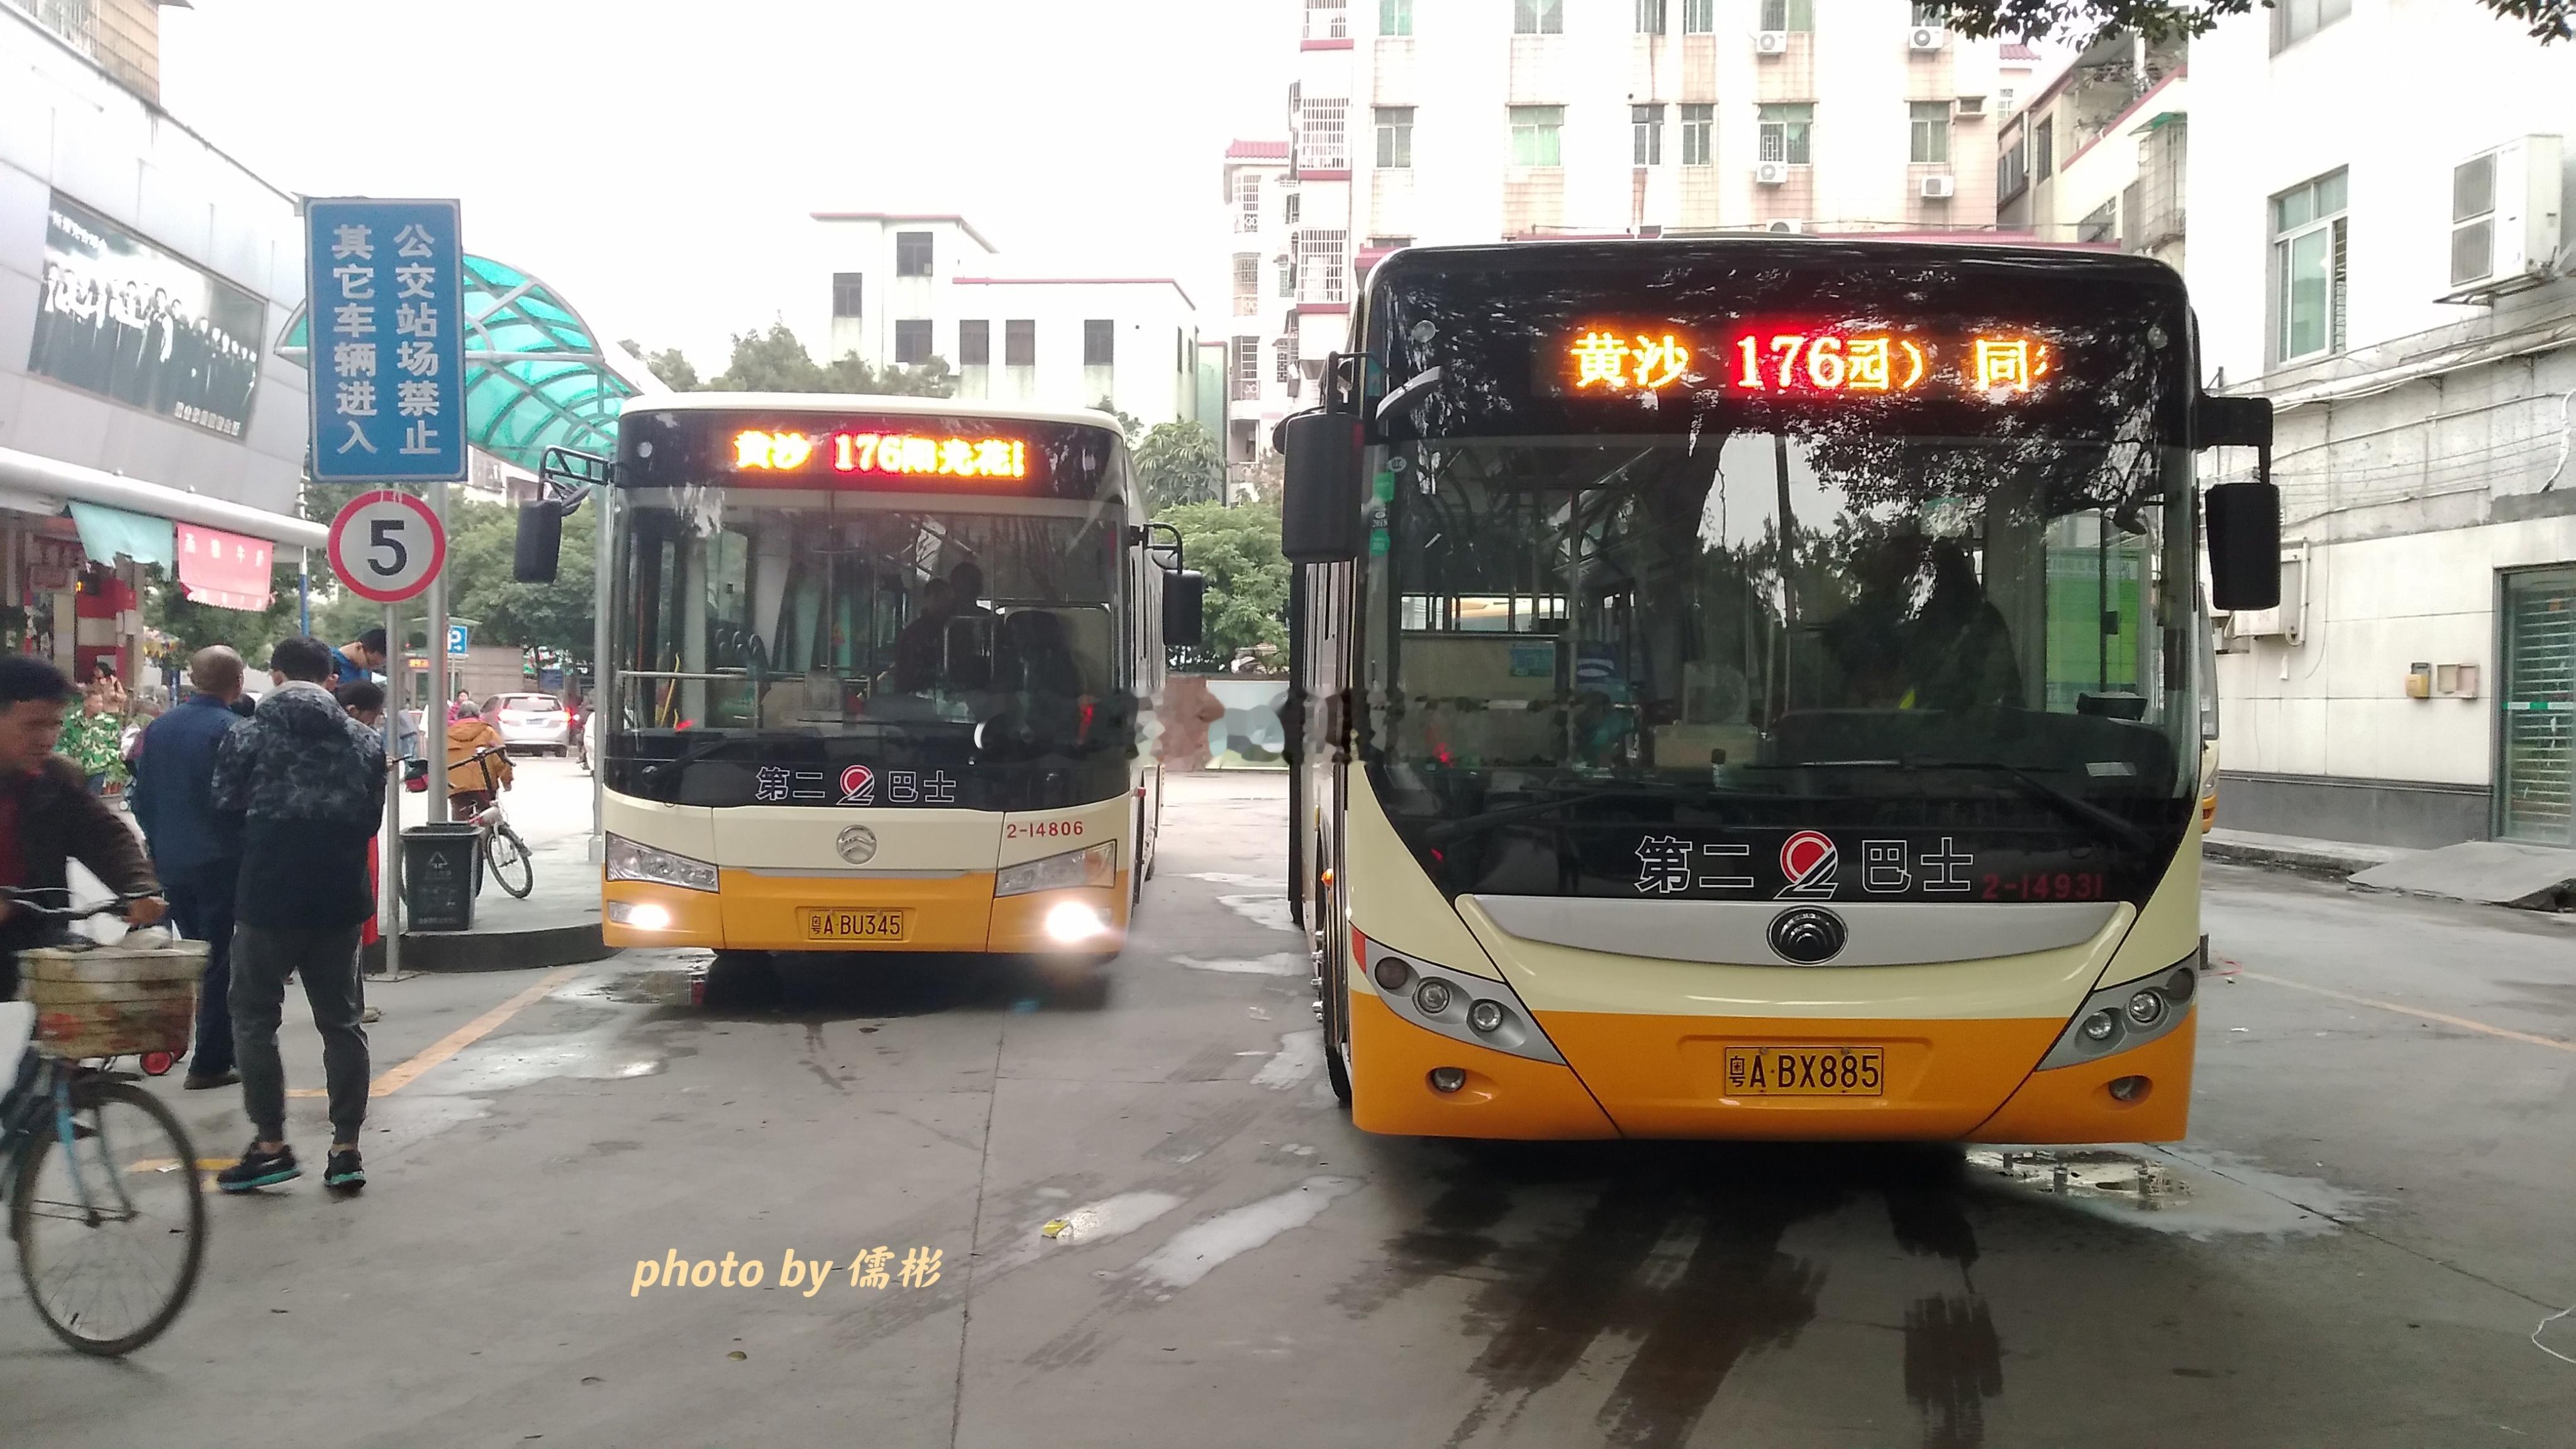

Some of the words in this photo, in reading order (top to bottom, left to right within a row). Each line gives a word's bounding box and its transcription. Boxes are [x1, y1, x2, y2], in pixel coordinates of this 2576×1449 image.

[332, 224, 377, 454] 其它车辆进入
[394, 224, 441, 454] 公交站场禁止
[1570, 332, 1690, 389] 黄沙
[1974, 338, 2048, 391] 同
[734, 431, 812, 469] 黄沙
[367, 519, 407, 576] 5
[447, 630, 462, 650] P
[755, 767, 825, 801] 第二
[888, 770, 957, 802] 巴士
[1007, 821, 1084, 839] 2-14806
[1634, 835, 1755, 894] 第二
[1862, 837, 1974, 893] 巴士
[1982, 872, 2104, 899] 2-14931
